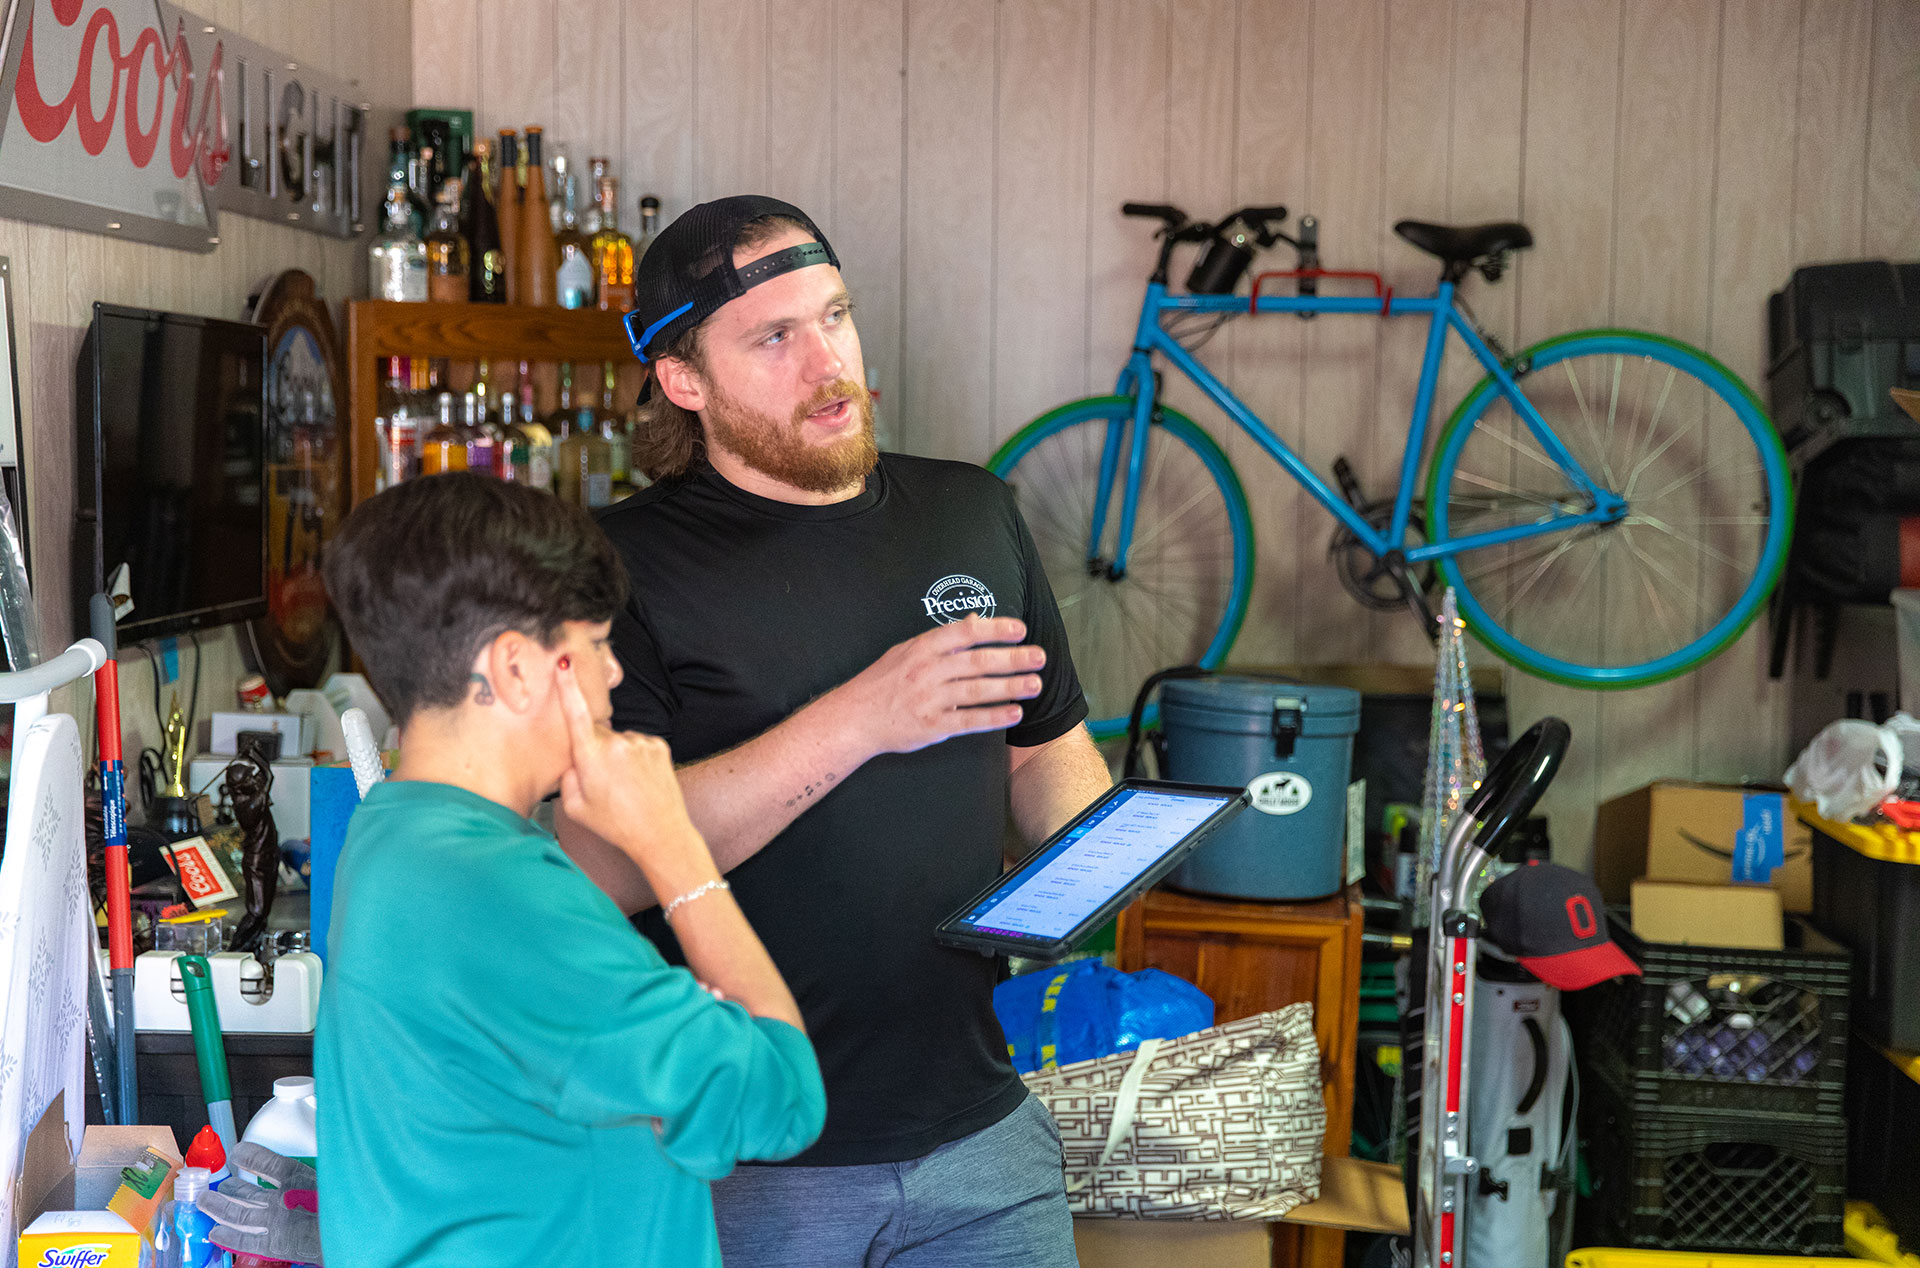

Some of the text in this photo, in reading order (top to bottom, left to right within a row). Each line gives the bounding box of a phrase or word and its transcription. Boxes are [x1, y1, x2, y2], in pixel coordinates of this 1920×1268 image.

[15, 0, 365, 236] Coors LIGHT
[920, 590, 998, 616] Precision
[931, 577, 986, 596] OVERHEAD GARAGE
[176, 852, 211, 896] Coors
[1565, 894, 1598, 940] O
[38, 1249, 107, 1268] Swiffer
